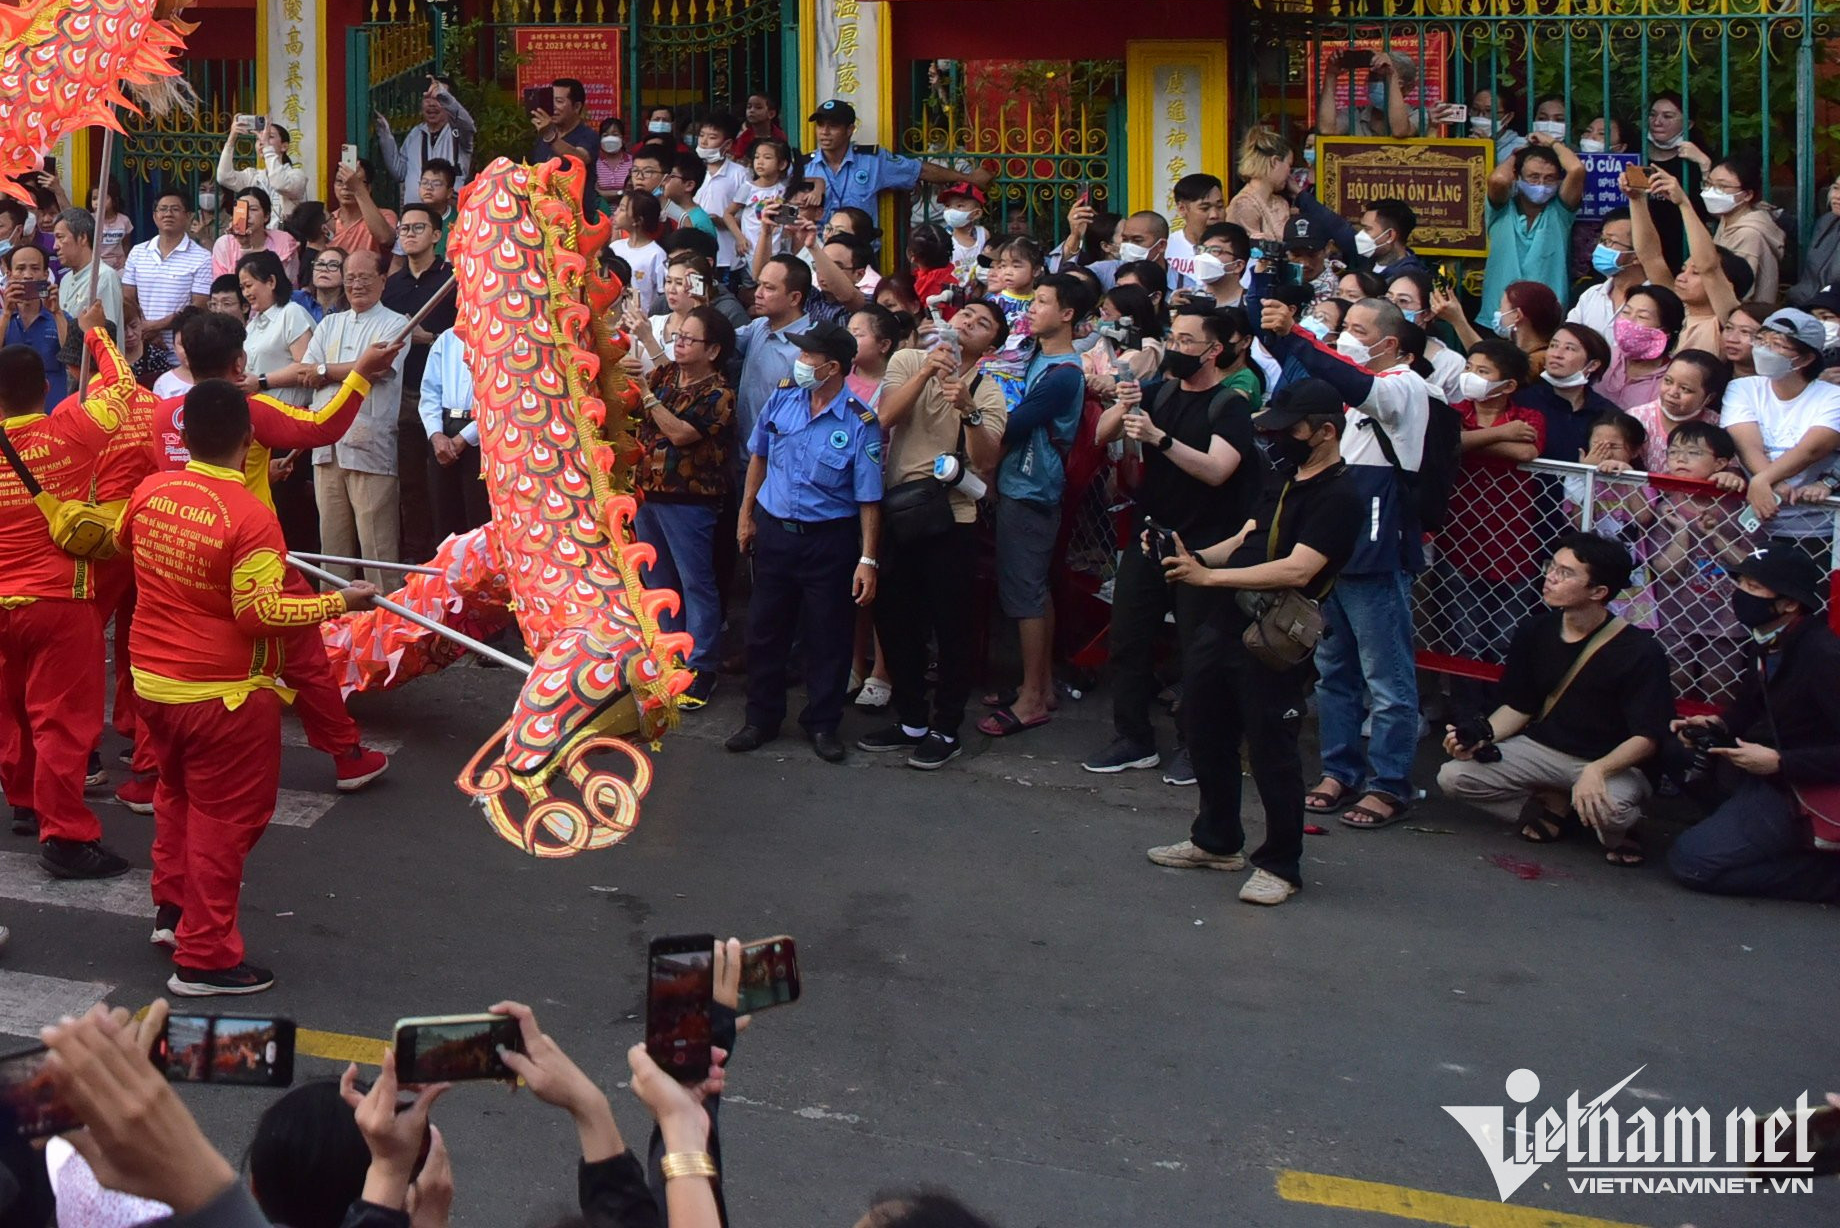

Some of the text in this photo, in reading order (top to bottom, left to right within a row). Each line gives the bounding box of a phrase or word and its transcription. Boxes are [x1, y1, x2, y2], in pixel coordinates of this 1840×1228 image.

[1597, 155, 1623, 173] CỬA
[1347, 178, 1462, 205] HỘI QUÁN ÔN LĂNG
[147, 495, 179, 516] HỮU
